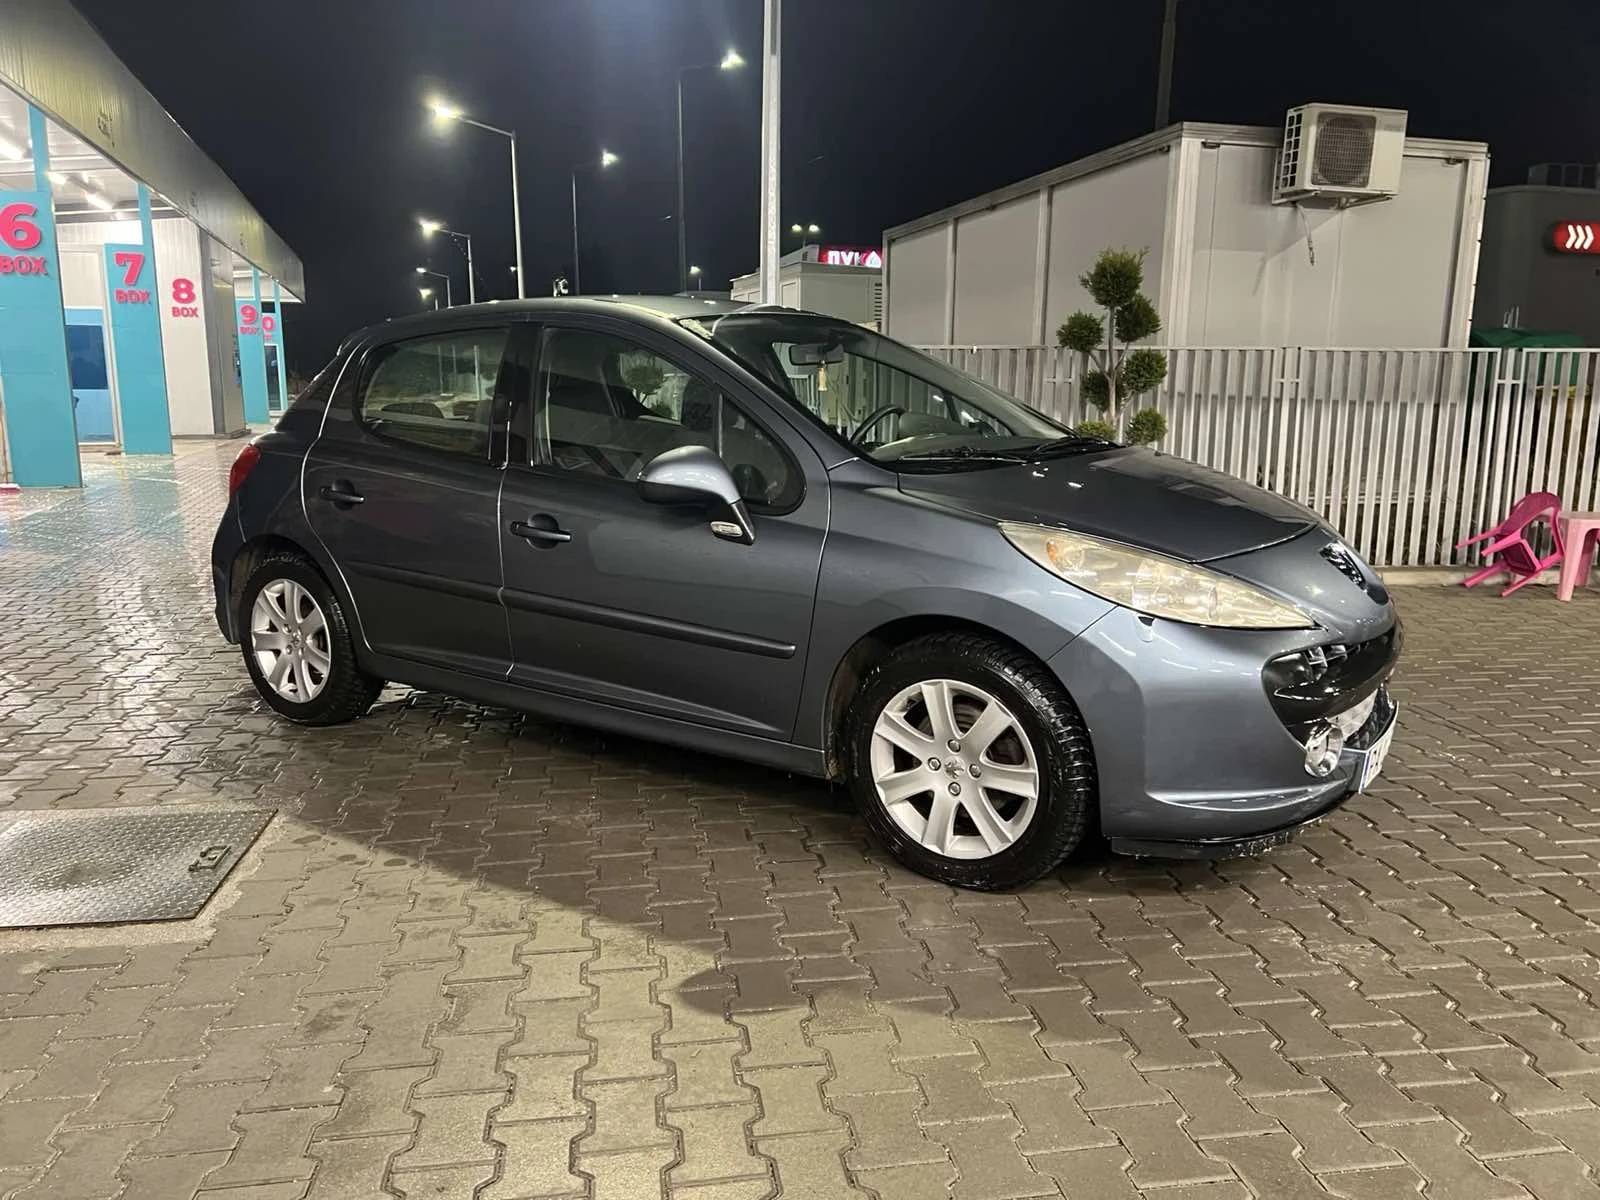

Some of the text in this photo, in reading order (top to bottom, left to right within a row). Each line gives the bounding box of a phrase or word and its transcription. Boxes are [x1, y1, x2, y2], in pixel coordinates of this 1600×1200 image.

[0, 202, 42, 250] 6
[0, 255, 48, 276] BOX
[114, 252, 145, 286] 7
[115, 289, 151, 304] BOX
[172, 278, 197, 304] 8
[172, 306, 199, 318] BOX
[240, 304, 257, 325] 9
[262, 315, 274, 331] 0
